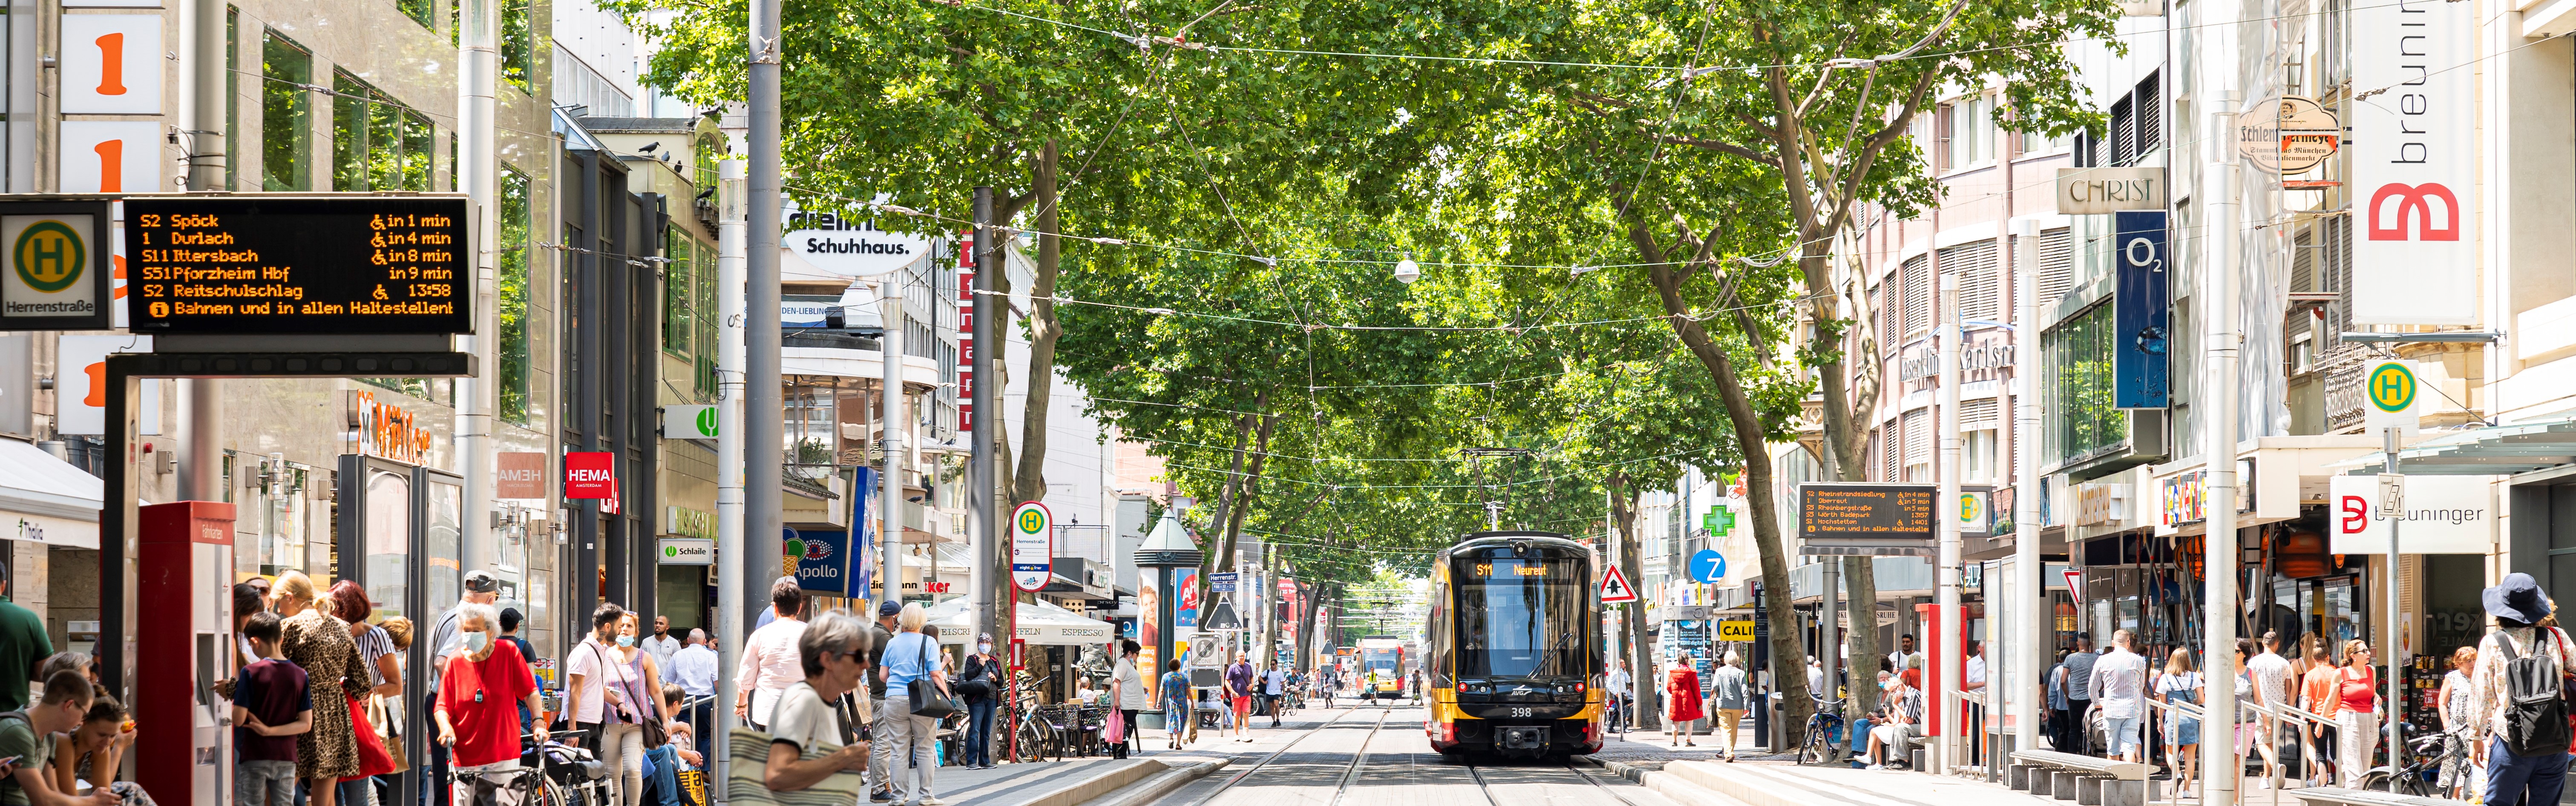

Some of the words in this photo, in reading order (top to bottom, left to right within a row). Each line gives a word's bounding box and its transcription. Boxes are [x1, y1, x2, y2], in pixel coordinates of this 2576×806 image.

[2069, 178, 2153, 202] CHRIST
[141, 215, 161, 227] S2
[171, 214, 219, 229] Spöck
[388, 214, 404, 227] in
[408, 214, 415, 227] 1
[421, 214, 450, 227] min
[143, 232, 150, 244] 1
[172, 232, 233, 244] Durlach
[389, 232, 404, 244] in
[407, 232, 417, 244] 4
[422, 232, 451, 244] min
[807, 238, 910, 255] Schuhhaus.
[142, 250, 168, 262] S11
[173, 250, 258, 262] Ittersbach
[389, 250, 405, 261] in
[408, 250, 417, 261] 8
[422, 250, 452, 261] min
[143, 267, 171, 279] S51
[173, 267, 256, 282] Pforzheim
[263, 267, 290, 282] Hbf
[390, 267, 406, 279] in
[409, 267, 418, 279] 9
[423, 267, 452, 279] min
[144, 285, 164, 297] S2
[174, 285, 302, 300] Reitschulschlag
[409, 284, 451, 296] 13:58
[6, 300, 94, 313] Herrenstraße
[175, 302, 233, 314] Bahnen
[240, 302, 270, 314] und
[277, 302, 294, 314] in
[301, 302, 343, 314] allen
[569, 470, 610, 481] HEMA
[2375, 506, 2484, 525] buninger
[202, 524, 223, 539] Fahrkarten
[795, 565, 838, 580] Apollo
[1477, 565, 1492, 576] S11
[1514, 565, 1546, 576] Neureut
[1511, 707, 1532, 717] 398
